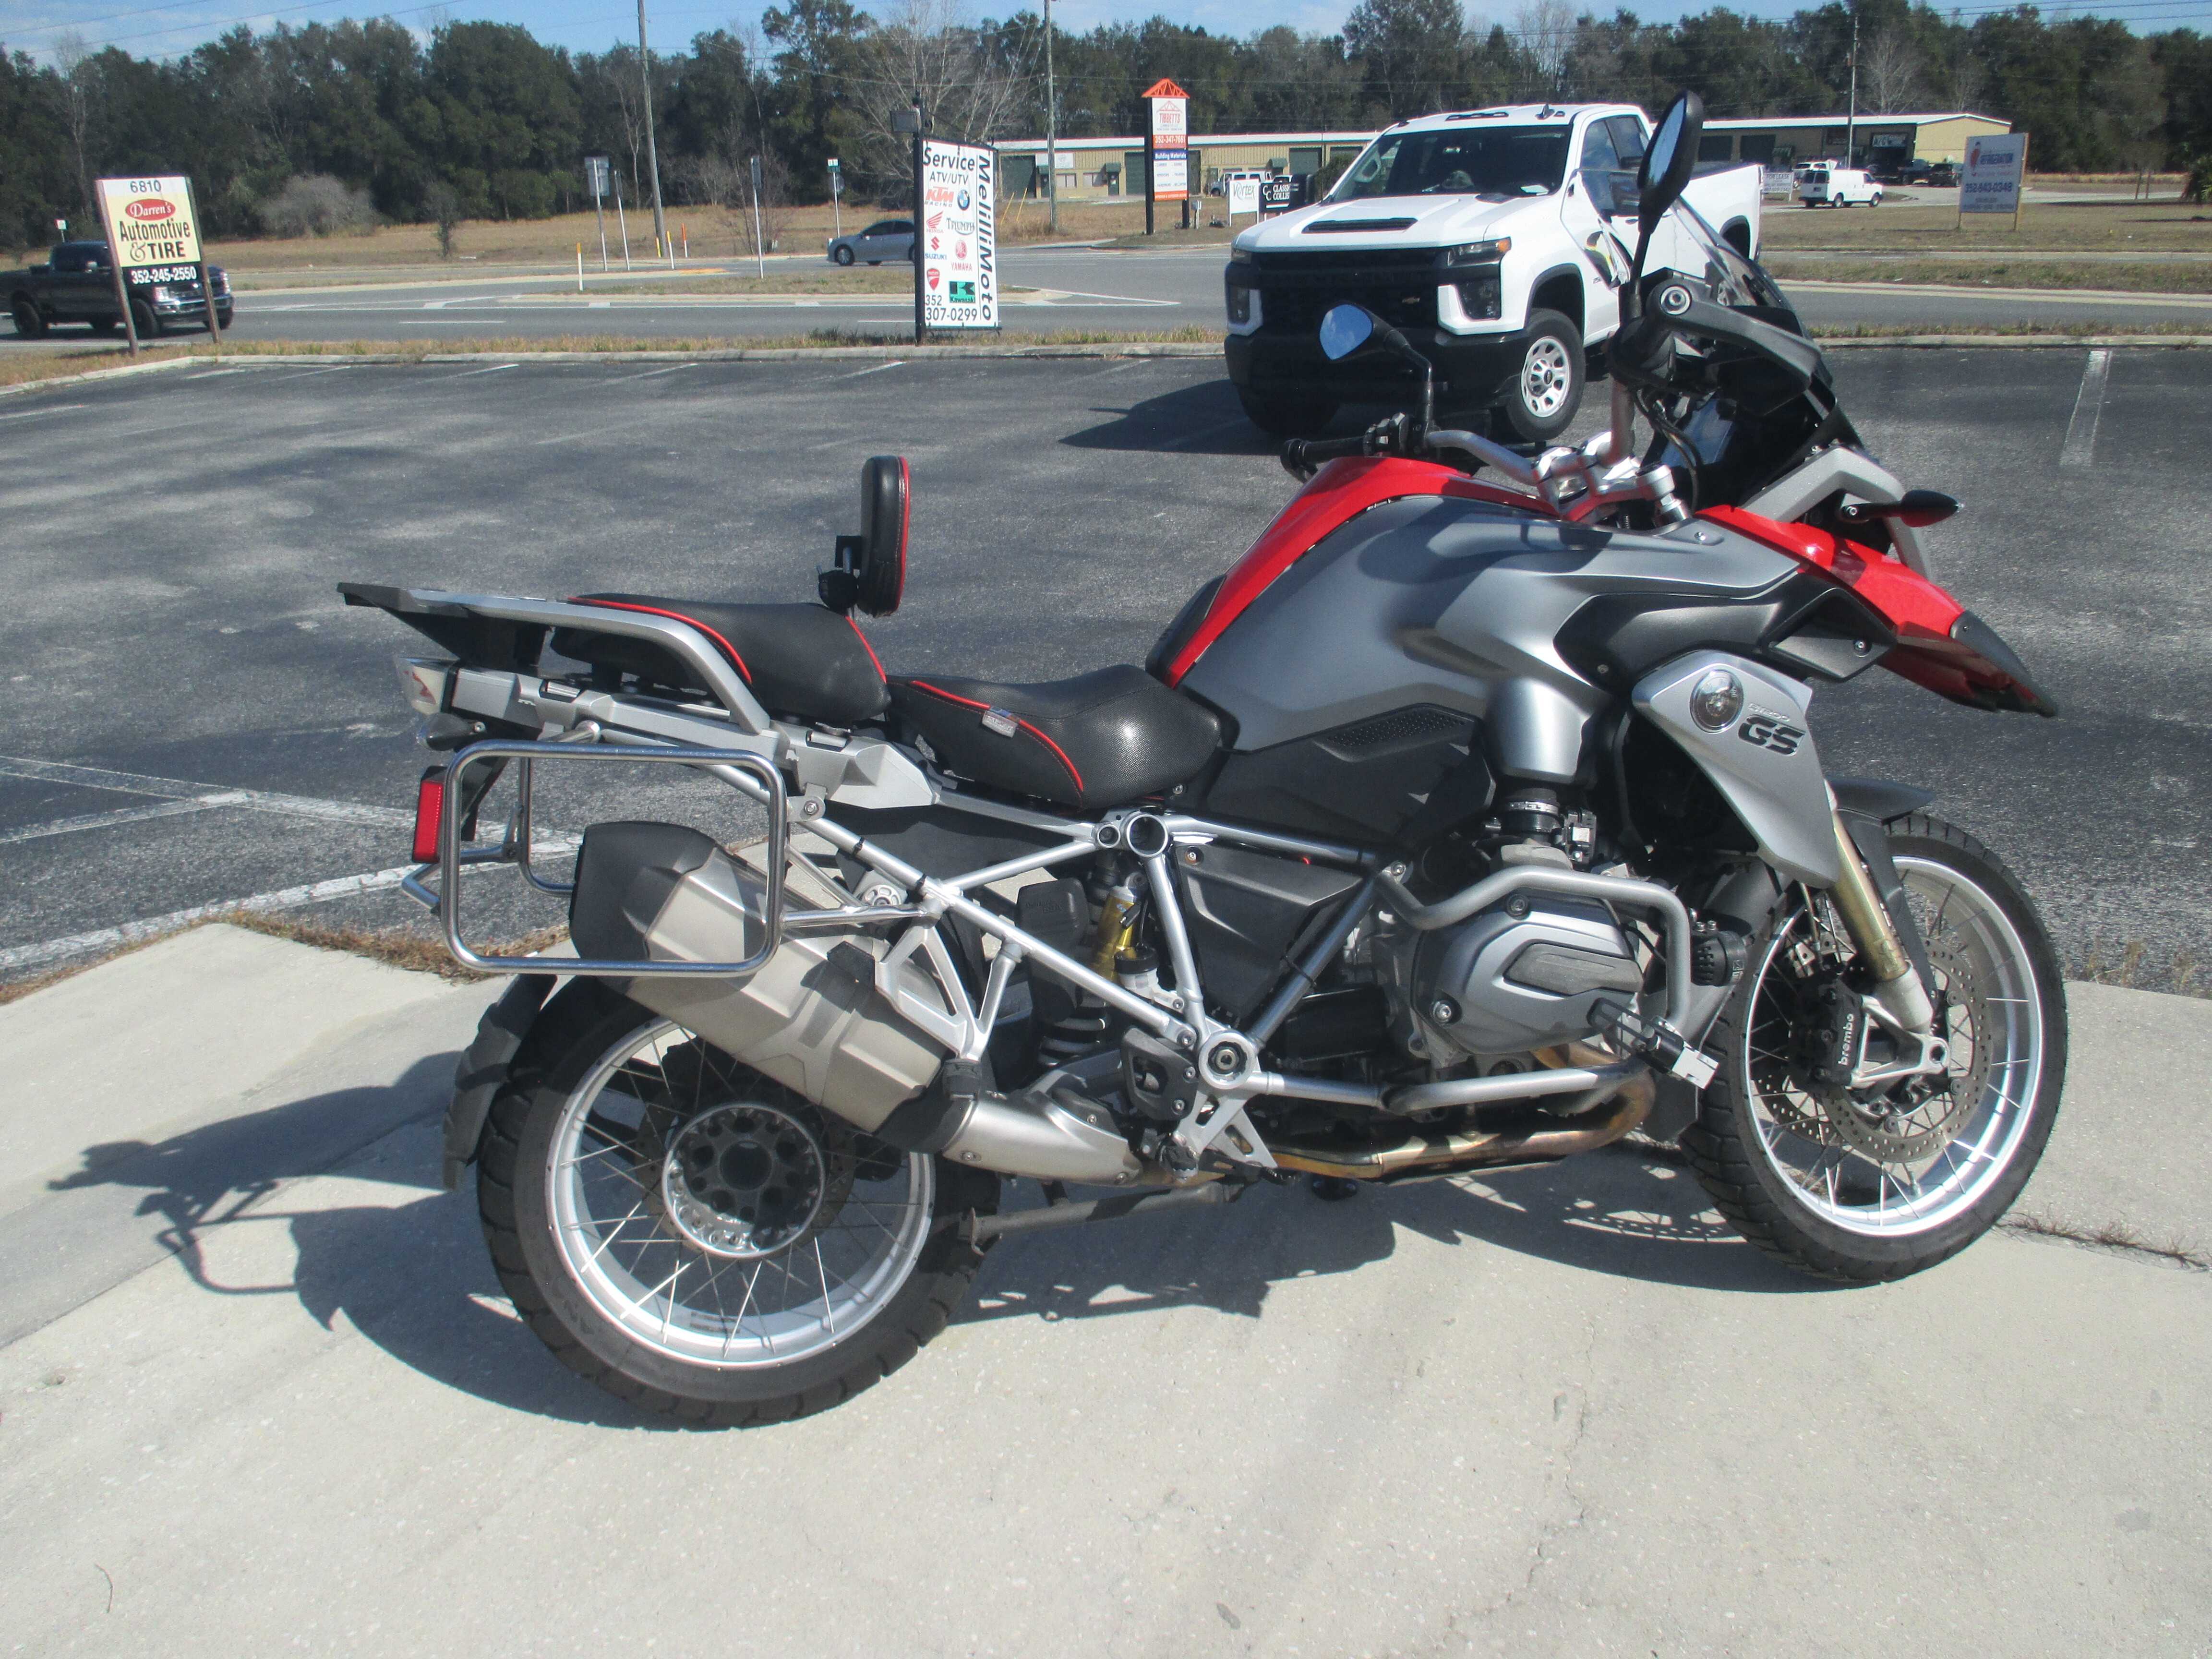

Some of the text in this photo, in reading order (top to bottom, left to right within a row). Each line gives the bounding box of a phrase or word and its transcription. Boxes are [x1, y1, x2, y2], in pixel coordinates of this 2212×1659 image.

[1159, 113, 1180, 123] TIBBETTS
[1155, 135, 1185, 144] 352-347-7661
[923, 146, 975, 172] Service
[929, 171, 969, 185] ATV/UTV
[130, 180, 162, 193] 6810
[1233, 183, 1255, 200] Vortex
[925, 186, 954, 203] KTM
[130, 203, 171, 217] Darren's
[120, 218, 191, 242] Automotive
[946, 217, 975, 232] TRIUMPH
[130, 241, 186, 262] & TIRE
[951, 262, 973, 271] YAMAHA
[131, 266, 197, 285] 352-245-2550
[925, 294, 942, 306] 352
[926, 307, 978, 321] 307-0299
[1738, 714, 1806, 756] GS
[1838, 1013, 1854, 1066] brembo
